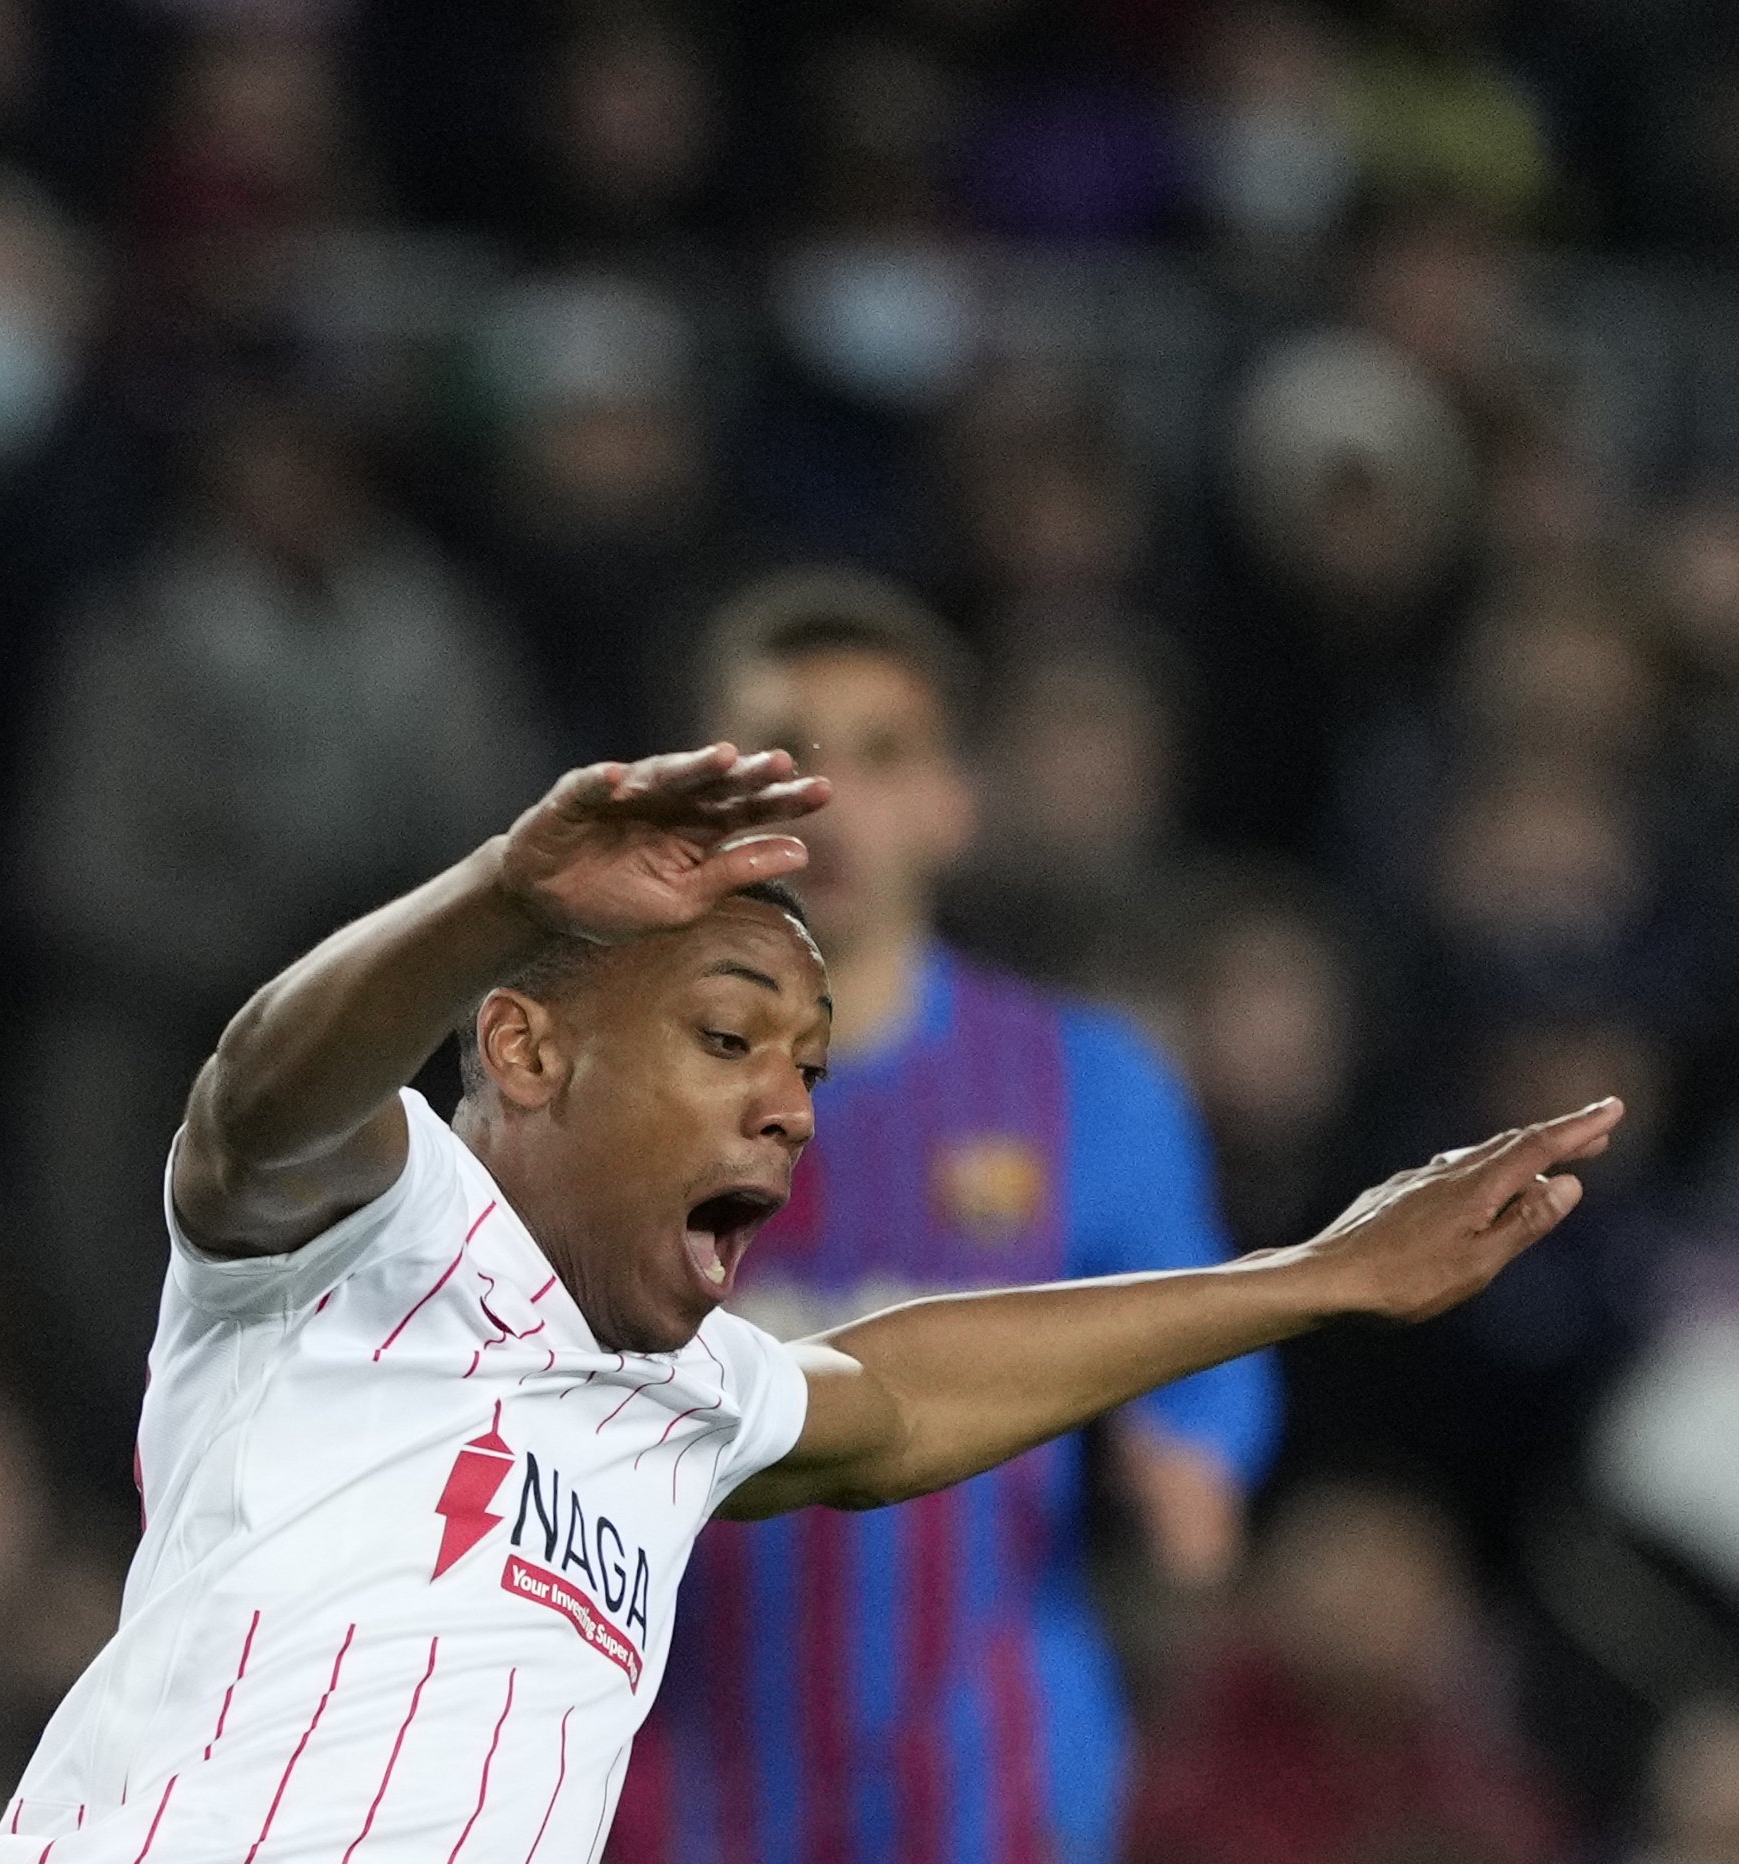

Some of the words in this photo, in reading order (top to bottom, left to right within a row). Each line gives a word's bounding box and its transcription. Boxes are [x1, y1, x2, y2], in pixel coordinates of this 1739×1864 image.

[509, 1450, 649, 1653] NAGA
[512, 1564, 550, 1599] Your
[551, 1583, 597, 1641] Investing
[595, 1623, 629, 1662] Super
